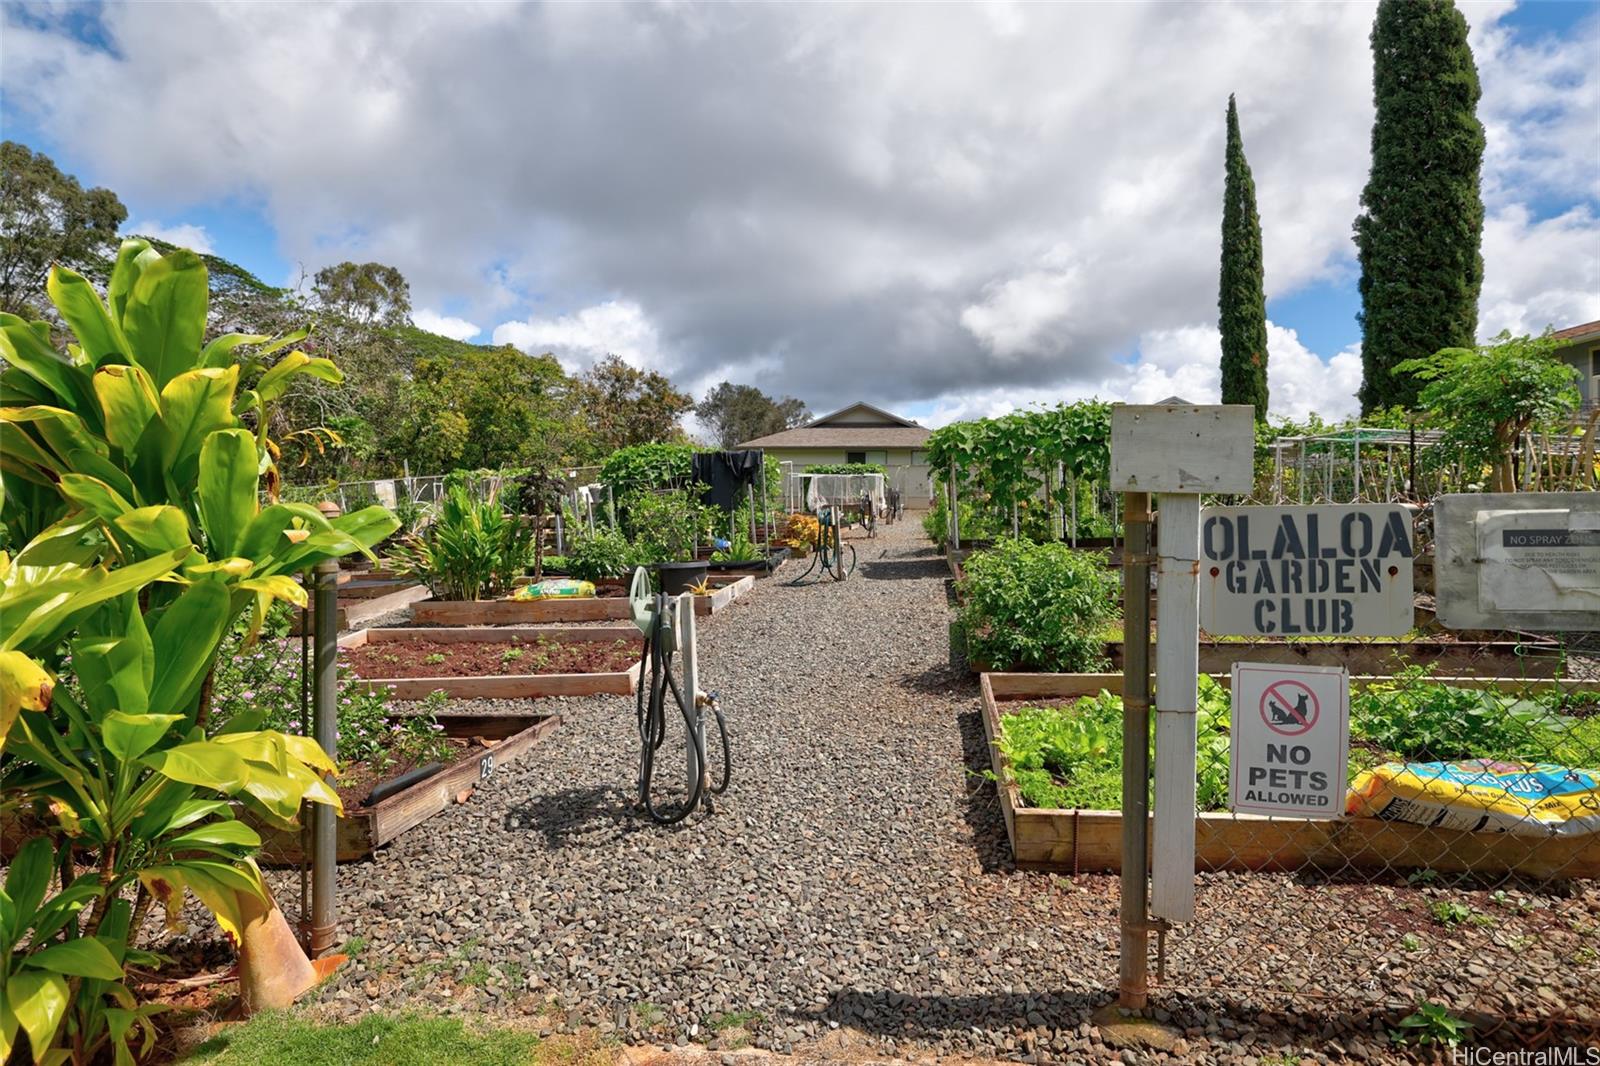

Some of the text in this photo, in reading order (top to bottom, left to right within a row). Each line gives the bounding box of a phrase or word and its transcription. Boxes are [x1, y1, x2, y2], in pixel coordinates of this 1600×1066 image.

[1203, 511, 1413, 561] OLALOA
[1510, 535, 1527, 544] NO
[1529, 535, 1562, 544] SPRAY
[1225, 559, 1381, 594] GARDEN
[1254, 598, 1354, 634] CLUB
[1267, 744, 1311, 765] NO
[481, 756, 493, 778] 29
[1249, 767, 1328, 791] PETS
[1245, 790, 1329, 807] ALLOWED
